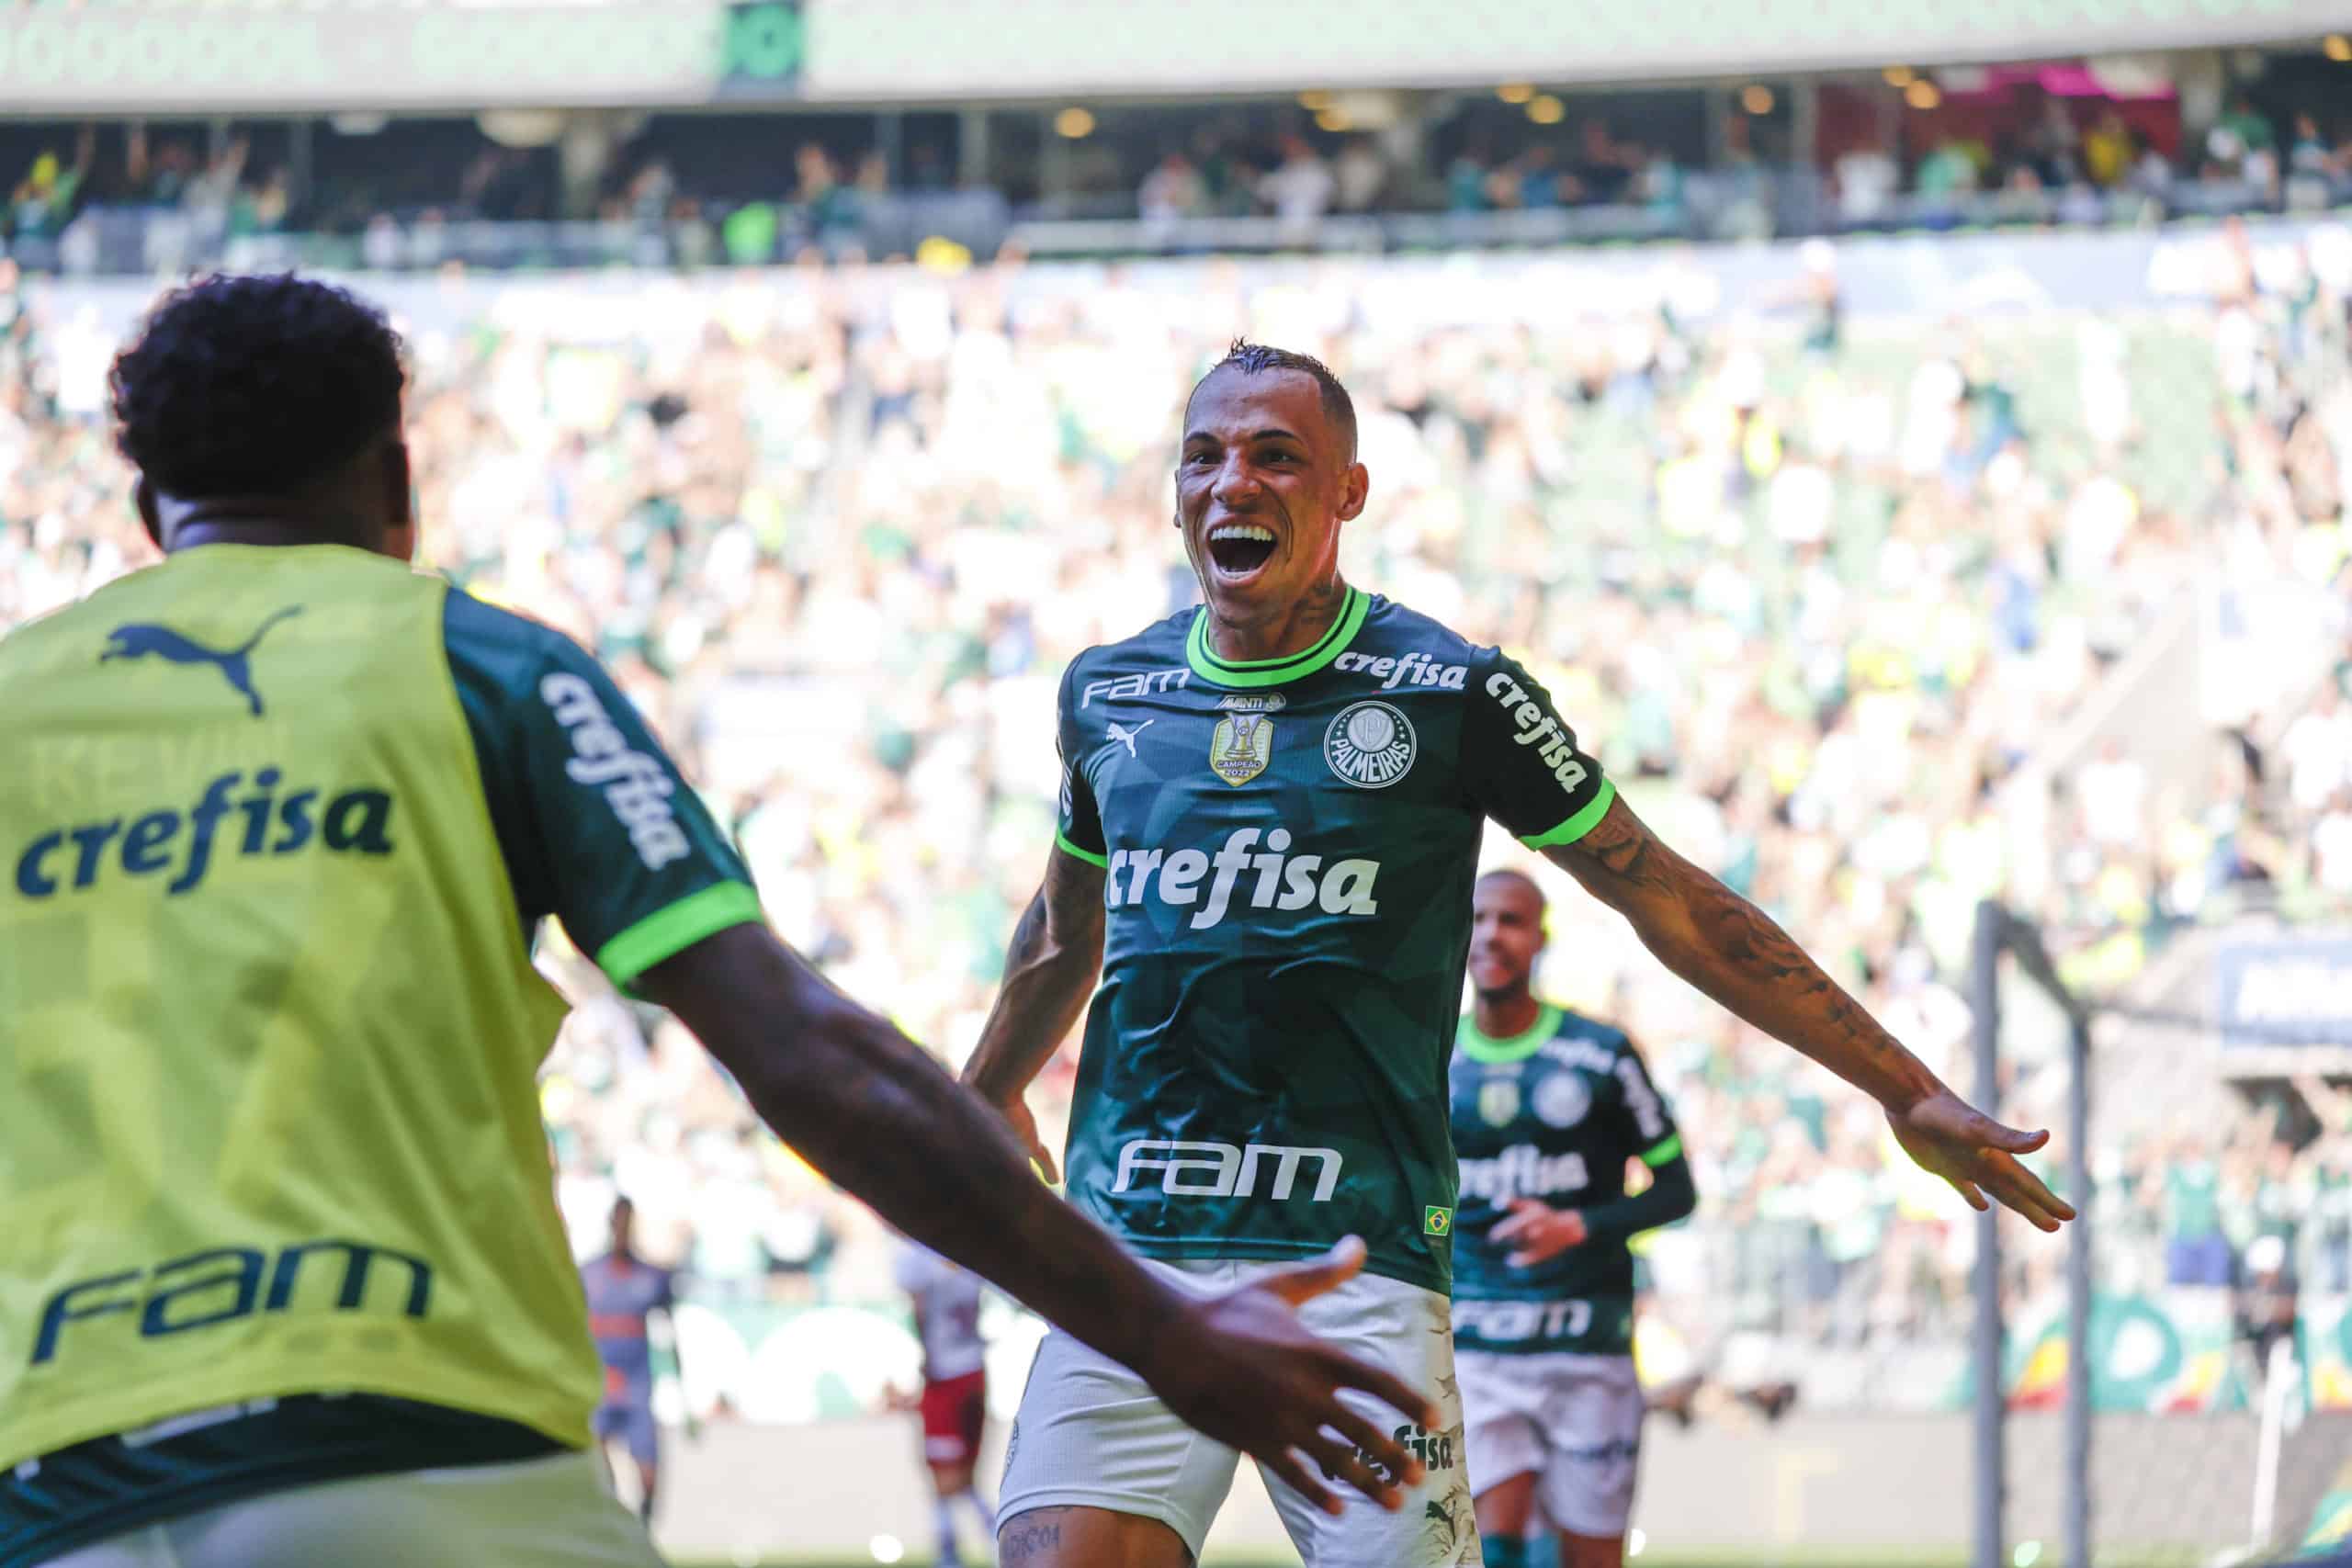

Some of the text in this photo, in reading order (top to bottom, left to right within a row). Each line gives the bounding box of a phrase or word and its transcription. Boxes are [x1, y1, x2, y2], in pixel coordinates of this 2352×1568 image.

[1334, 651, 1469, 690] crefisa
[540, 671, 691, 872] crefisa
[1330, 739, 1410, 782] PALMEIRAS
[1485, 671, 1589, 794] crefisa
[17, 764, 395, 897] crefisa
[1108, 828, 1379, 931] crefisa
